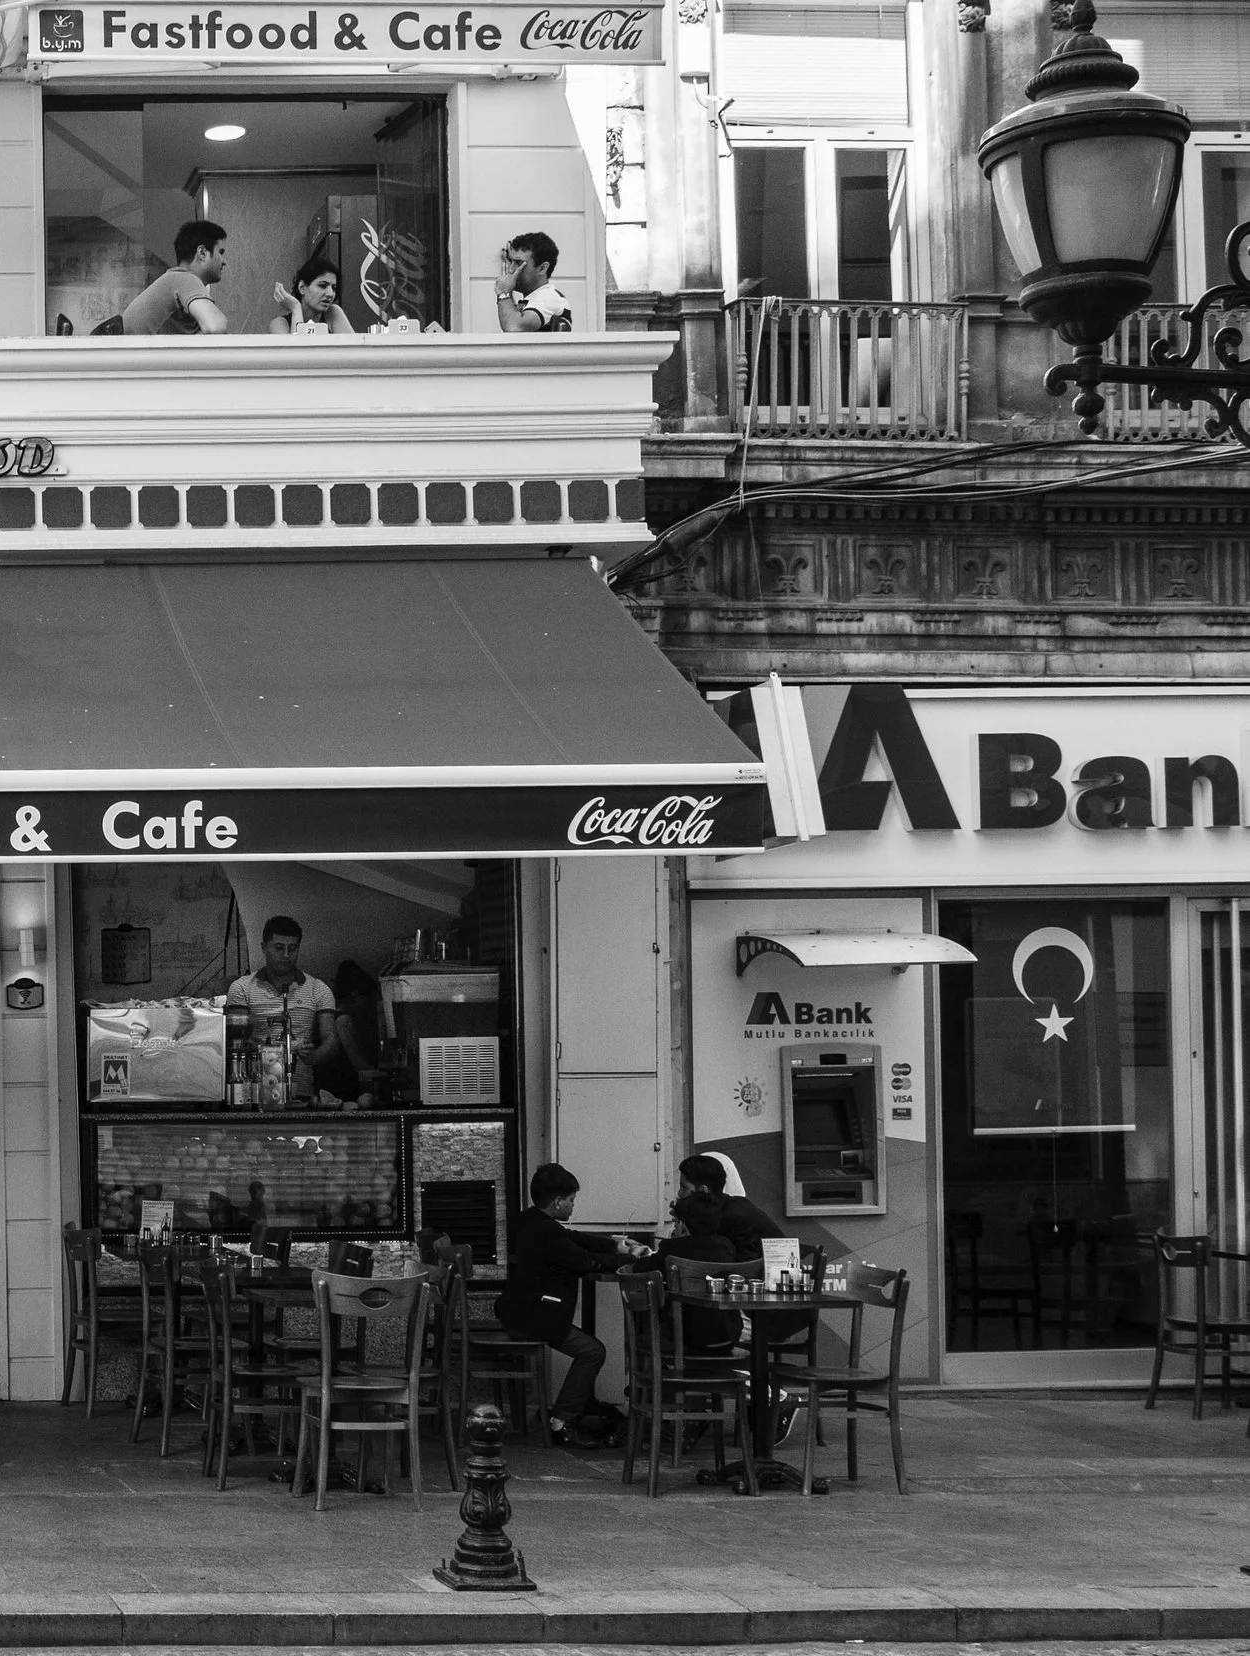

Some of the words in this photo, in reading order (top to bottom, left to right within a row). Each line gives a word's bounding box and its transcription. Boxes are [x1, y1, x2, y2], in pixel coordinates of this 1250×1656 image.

[42, 36, 82, 52] b.y.m
[103, 10, 317, 50] Fastfood
[333, 13, 368, 50] &
[389, 11, 502, 51] Cafe
[519, 10, 648, 51] Coca-Cola
[10, 806, 52, 853] &
[102, 800, 239, 850] Cafe
[566, 795, 723, 846] Coca-Cola
[744, 1029, 785, 1039] Mutlu
[794, 1028, 875, 1038] Bankacılık
[892, 1095, 913, 1103] VISA
[821, 1279, 847, 1292] TM
